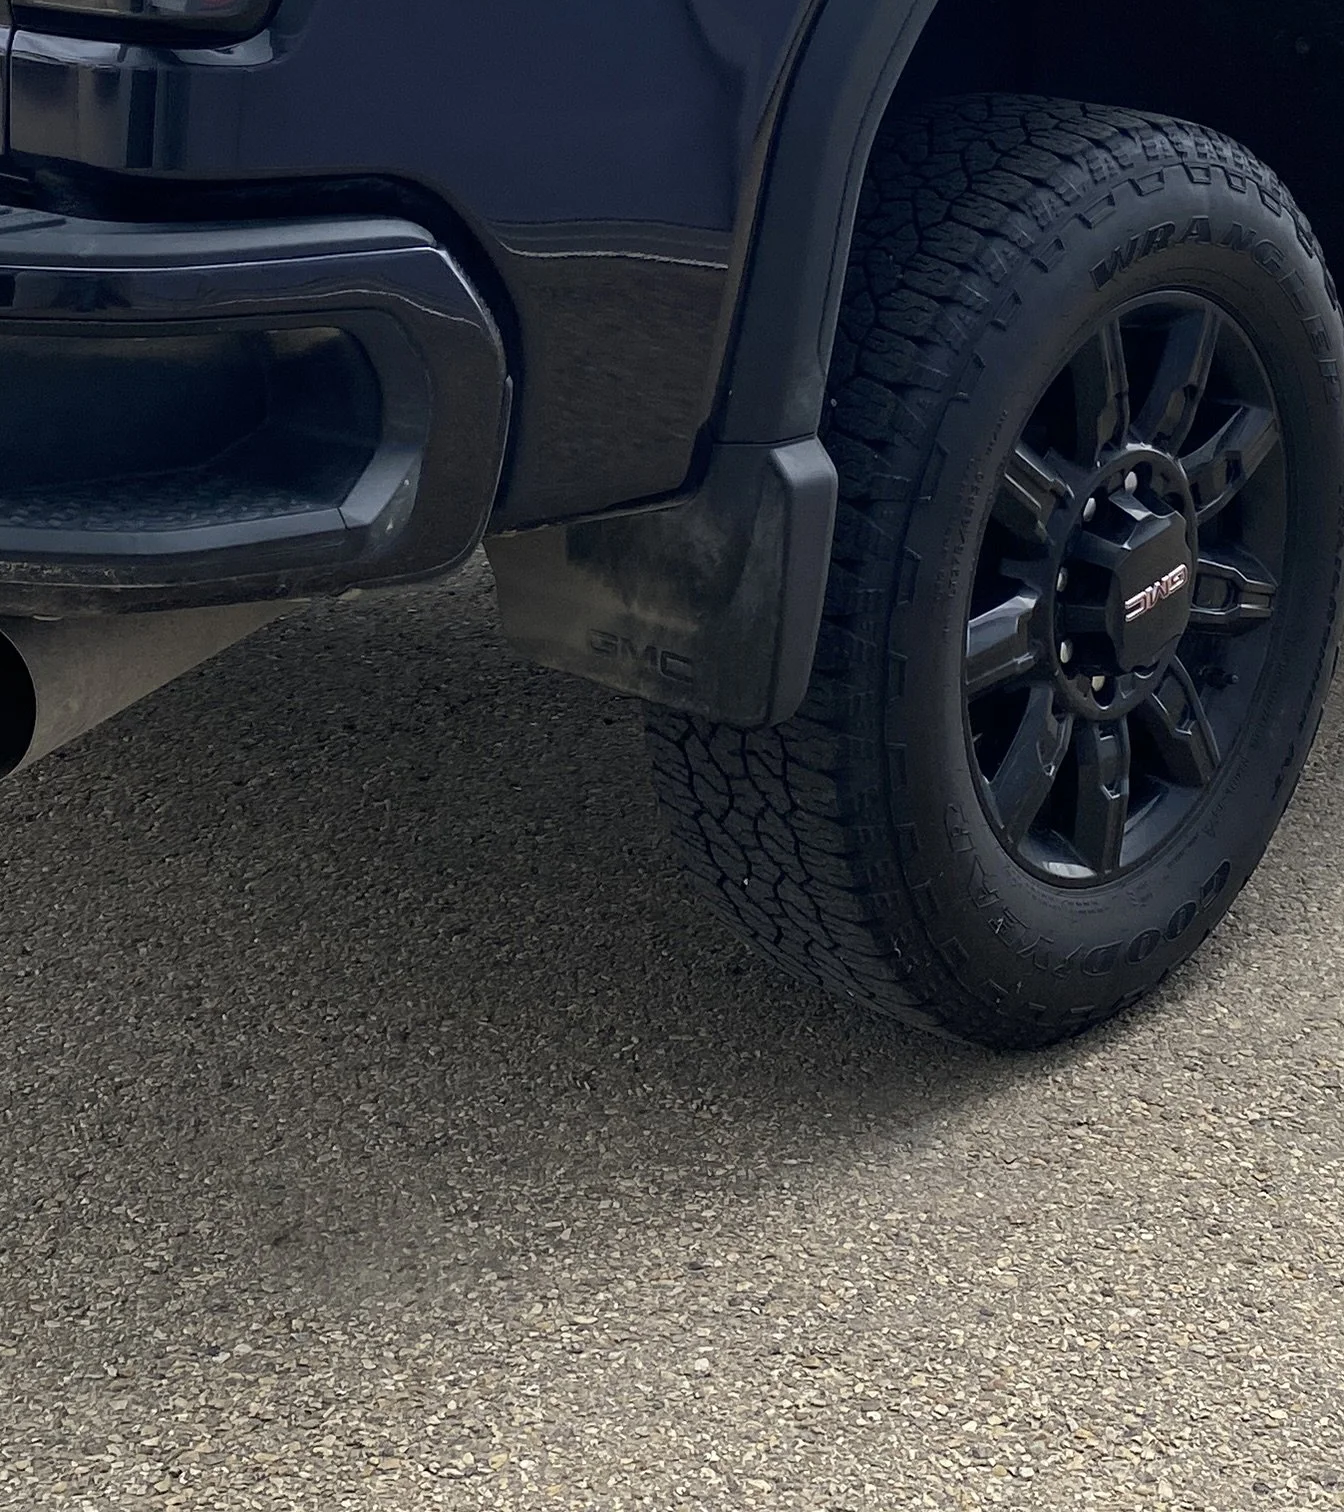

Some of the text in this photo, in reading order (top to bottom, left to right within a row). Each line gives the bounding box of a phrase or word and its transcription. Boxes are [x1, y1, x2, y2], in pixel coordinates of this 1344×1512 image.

[1087, 216, 1341, 404] WRANGLER
[1124, 564, 1189, 622] GMC
[586, 628, 694, 684] GMC
